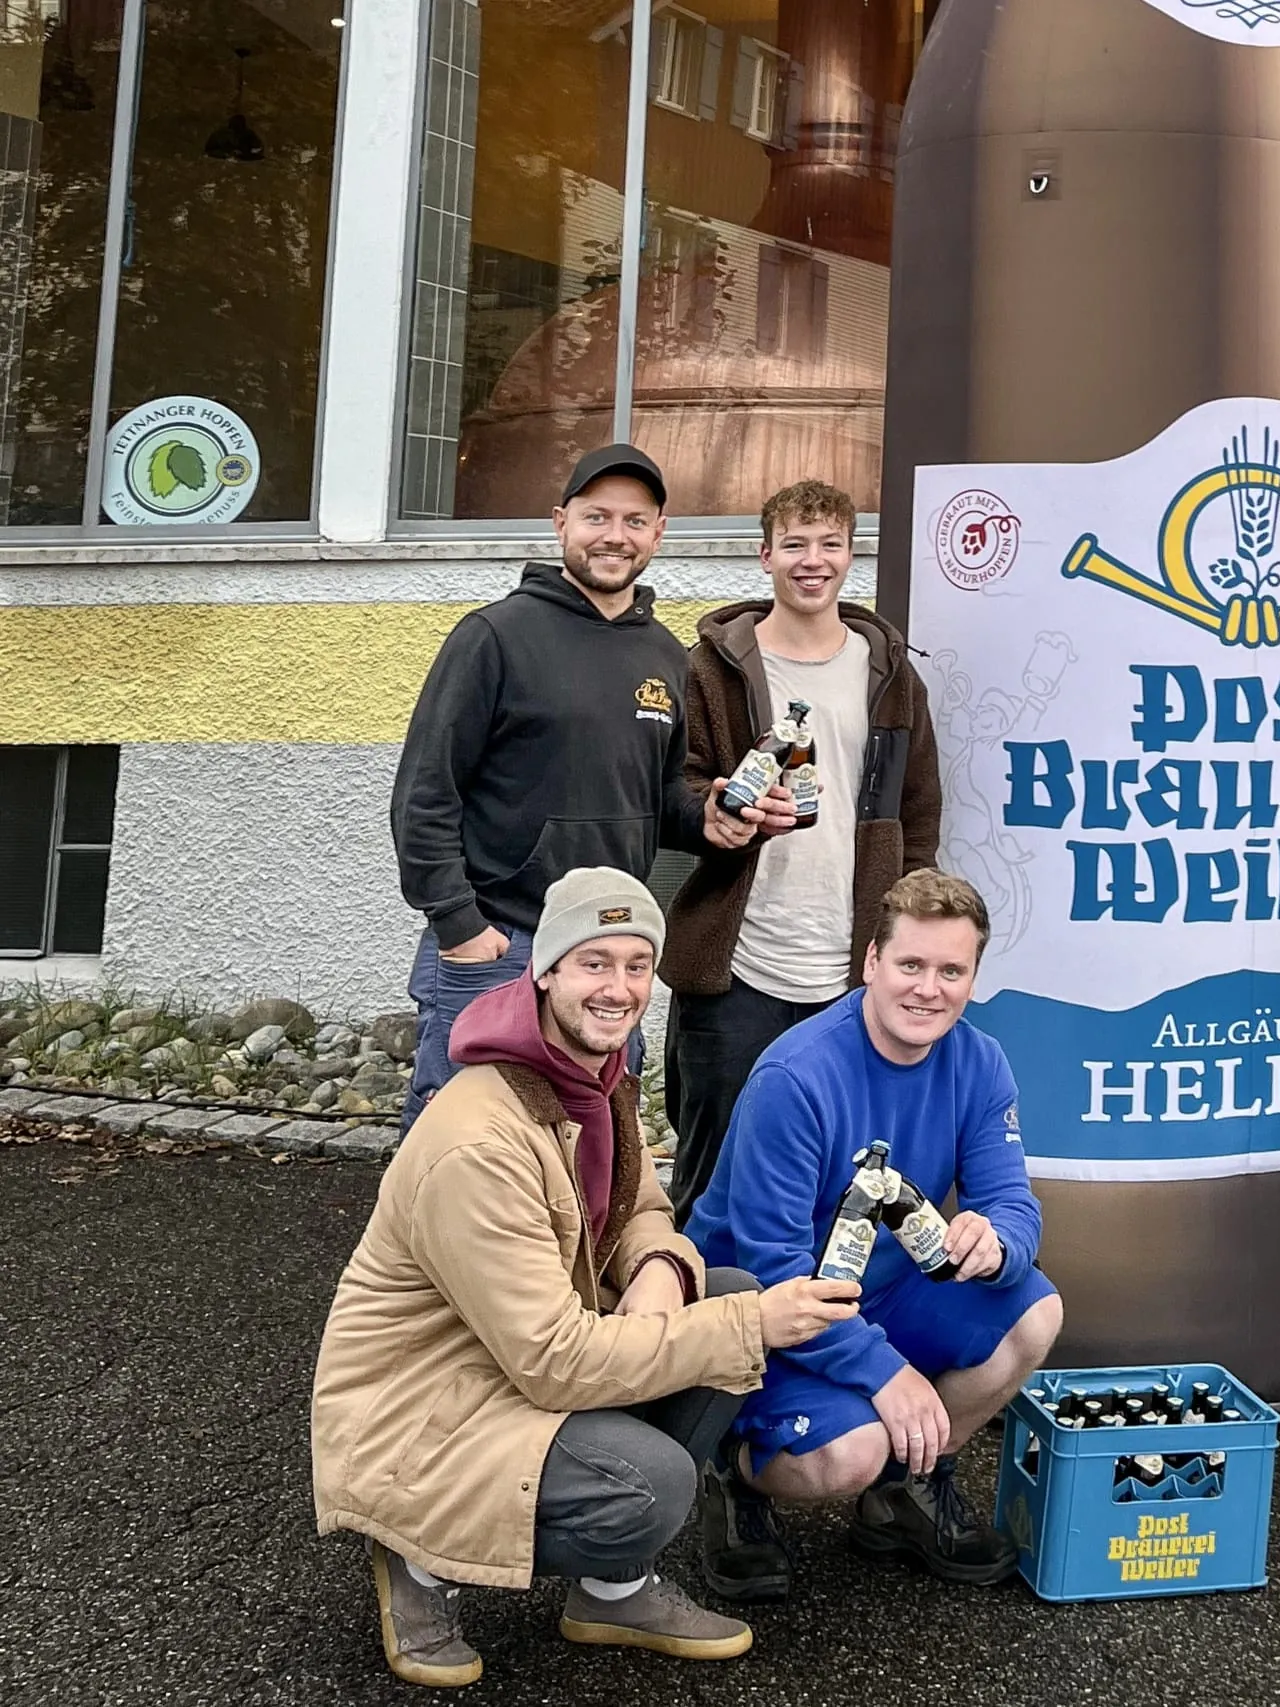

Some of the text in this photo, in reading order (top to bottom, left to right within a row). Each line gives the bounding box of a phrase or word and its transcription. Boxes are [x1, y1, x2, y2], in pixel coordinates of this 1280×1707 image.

[112, 405, 247, 456] TETTNANGER HOPFEN
[940, 495, 999, 547] GEBRAUT MIT
[944, 537, 1012, 584] NATURHOPFEN
[1137, 1512, 1190, 1538] Post
[1107, 1530, 1217, 1560] Brauerei
[1120, 1556, 1201, 1581] Weiler
